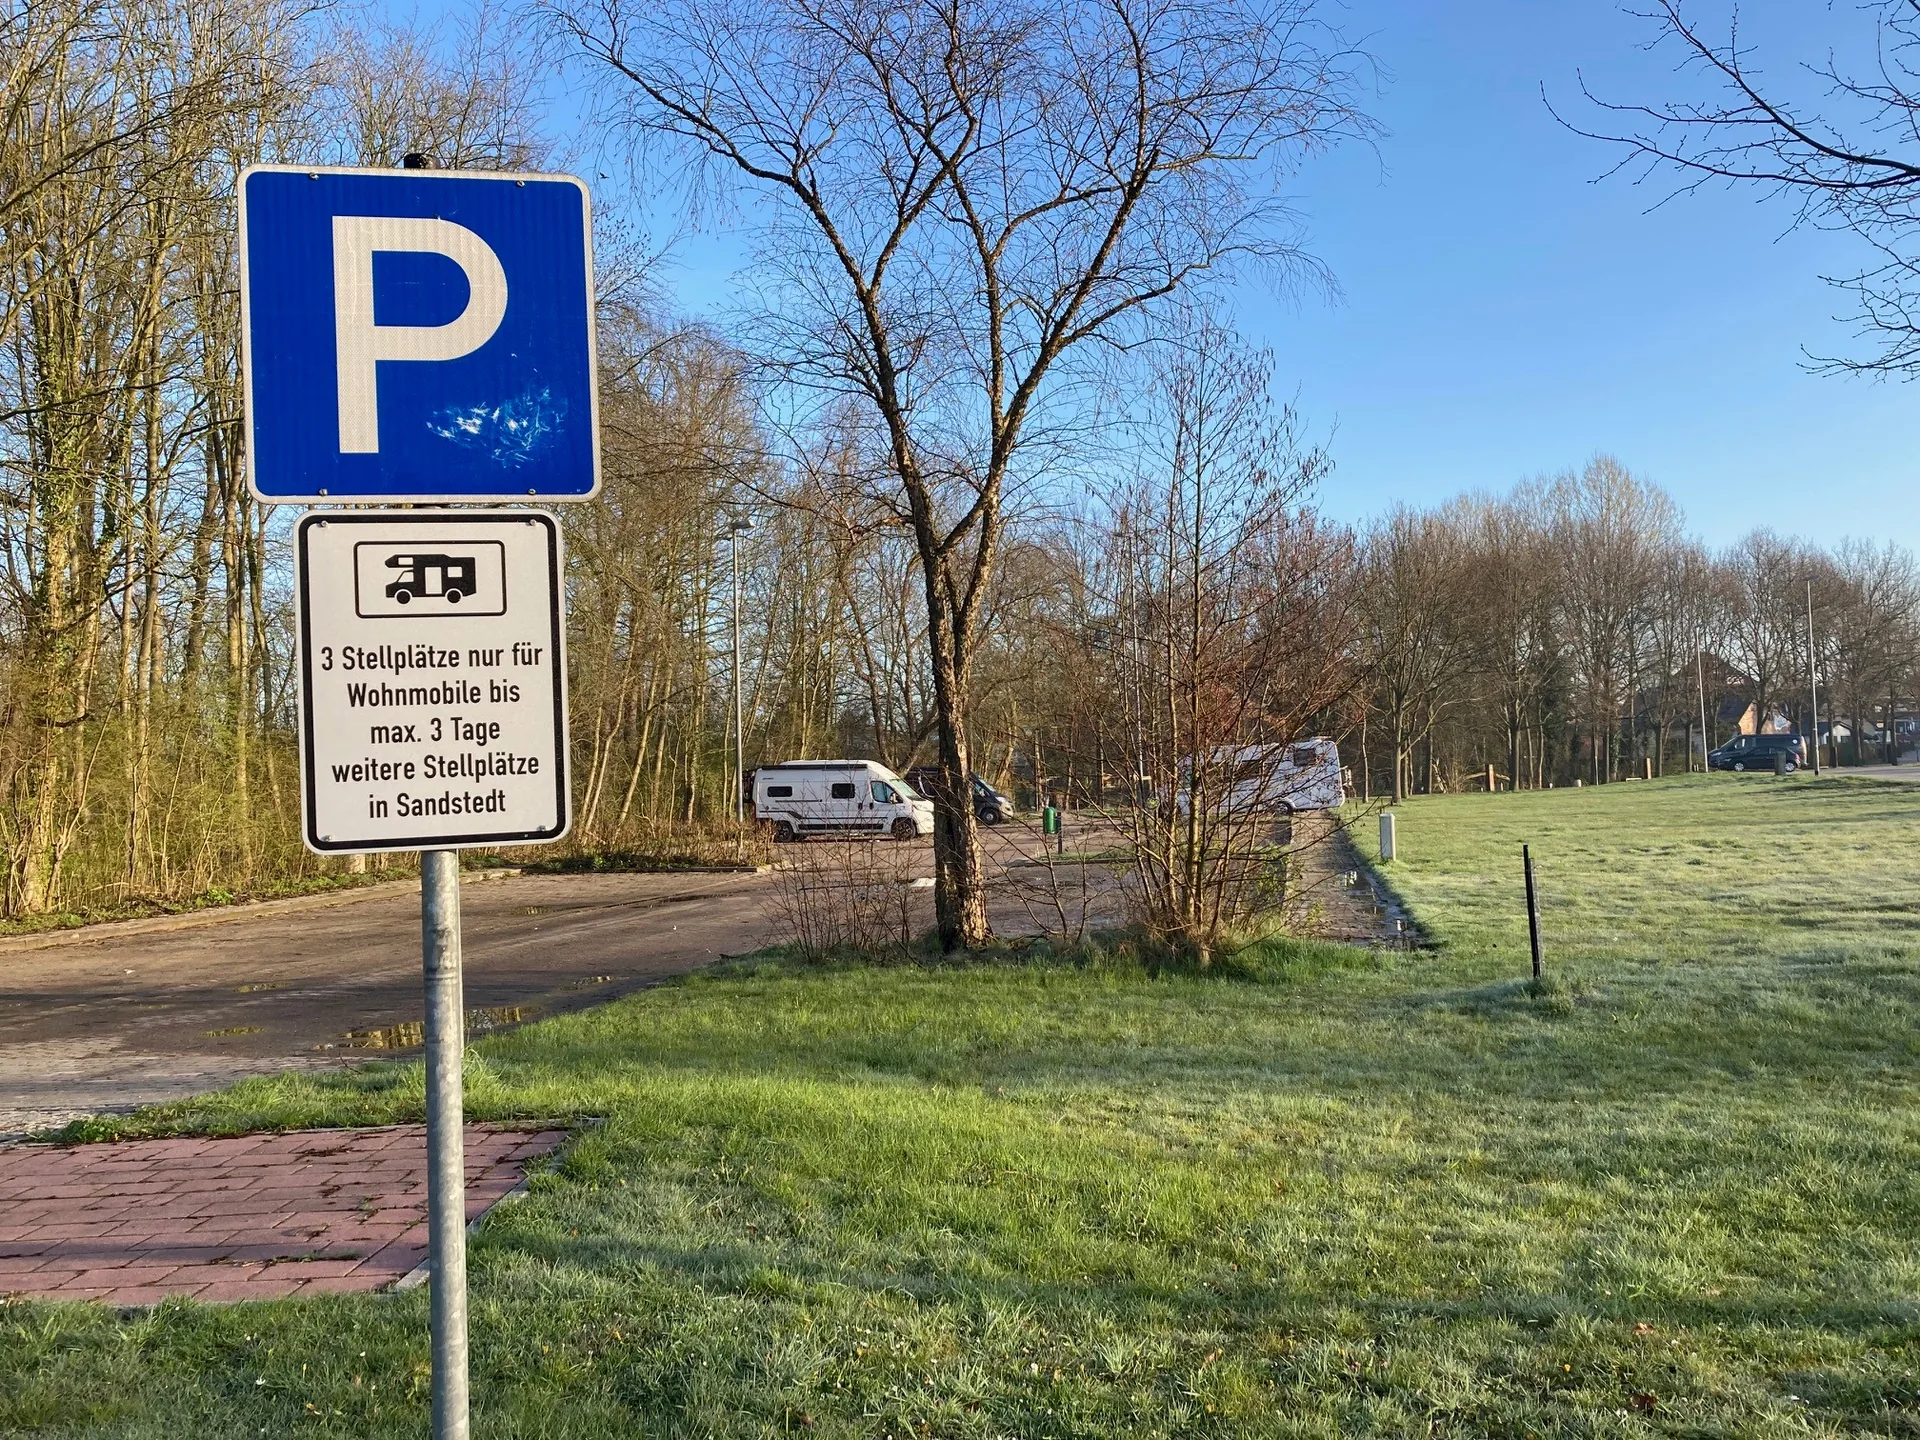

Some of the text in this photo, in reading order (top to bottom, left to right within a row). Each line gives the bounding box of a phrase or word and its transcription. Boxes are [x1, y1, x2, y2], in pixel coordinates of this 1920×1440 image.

[332, 215, 508, 453] P
[320, 641, 543, 676] 3 Stellplätze nur für
[346, 678, 521, 708] Wohnmobile bis
[370, 716, 501, 747] max. 3 Tage
[331, 751, 540, 784] weitere Stellplätze
[369, 788, 506, 819] in Sandstedt
